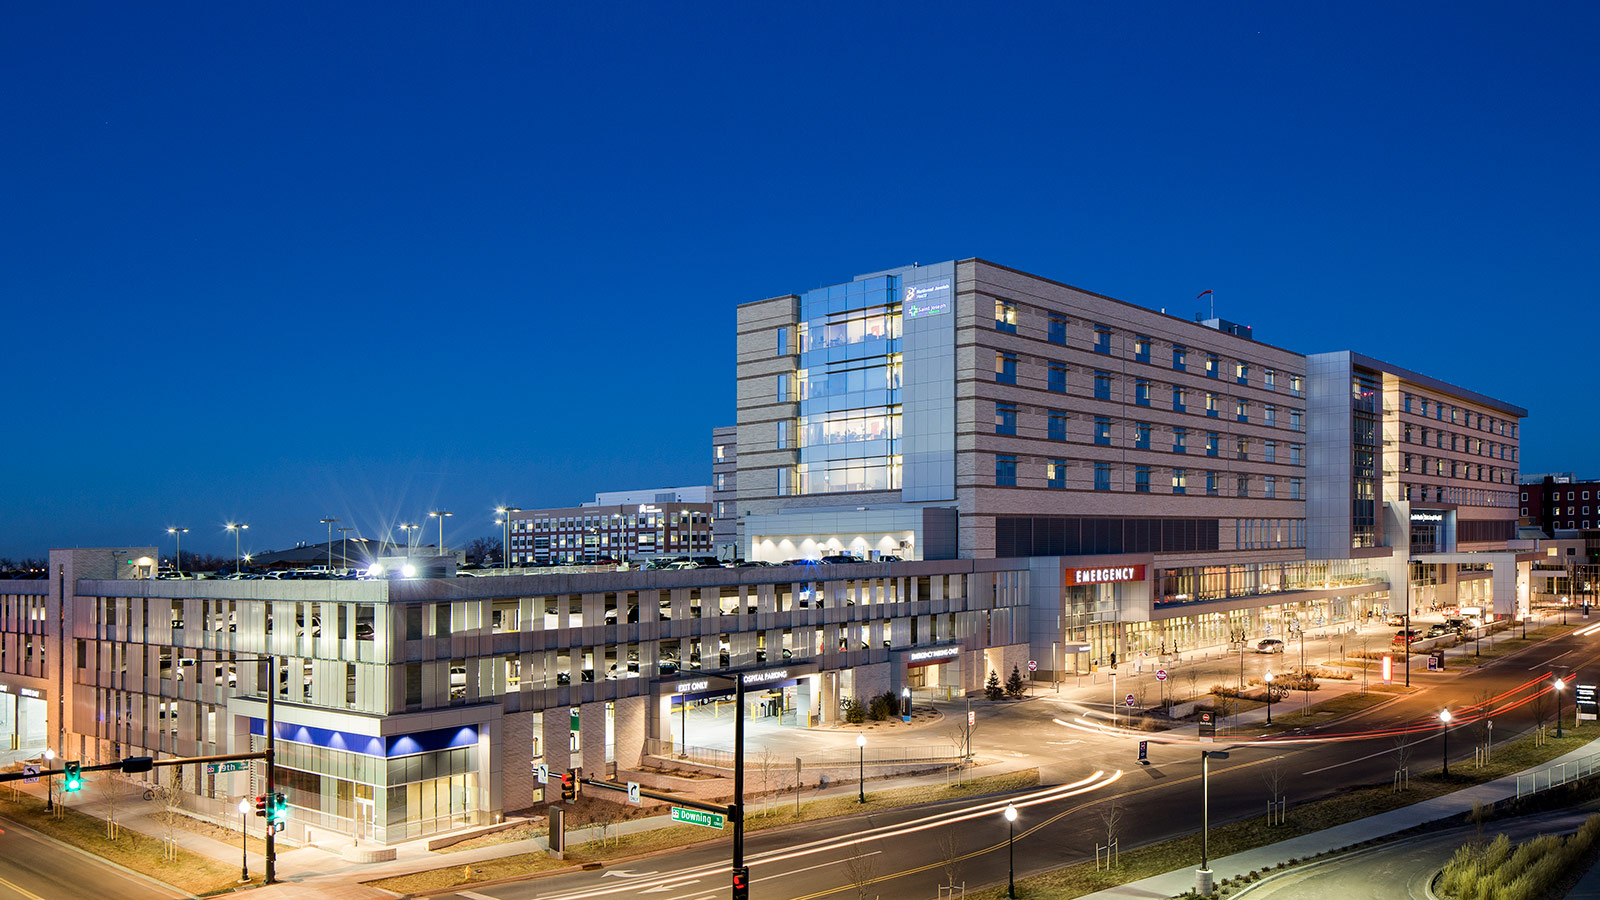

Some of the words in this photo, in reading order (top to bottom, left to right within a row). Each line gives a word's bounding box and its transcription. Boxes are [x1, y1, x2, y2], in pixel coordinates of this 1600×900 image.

[931, 303, 946, 311] Joseph
[1075, 567, 1134, 583] EMERGENCY
[743, 674, 764, 684] OSPITAL
[764, 670, 788, 681] PARKING
[678, 682, 691, 692] EXIT
[692, 681, 708, 691] ONLY
[218, 763, 236, 772] 19th
[681, 810, 712, 826] Downing
